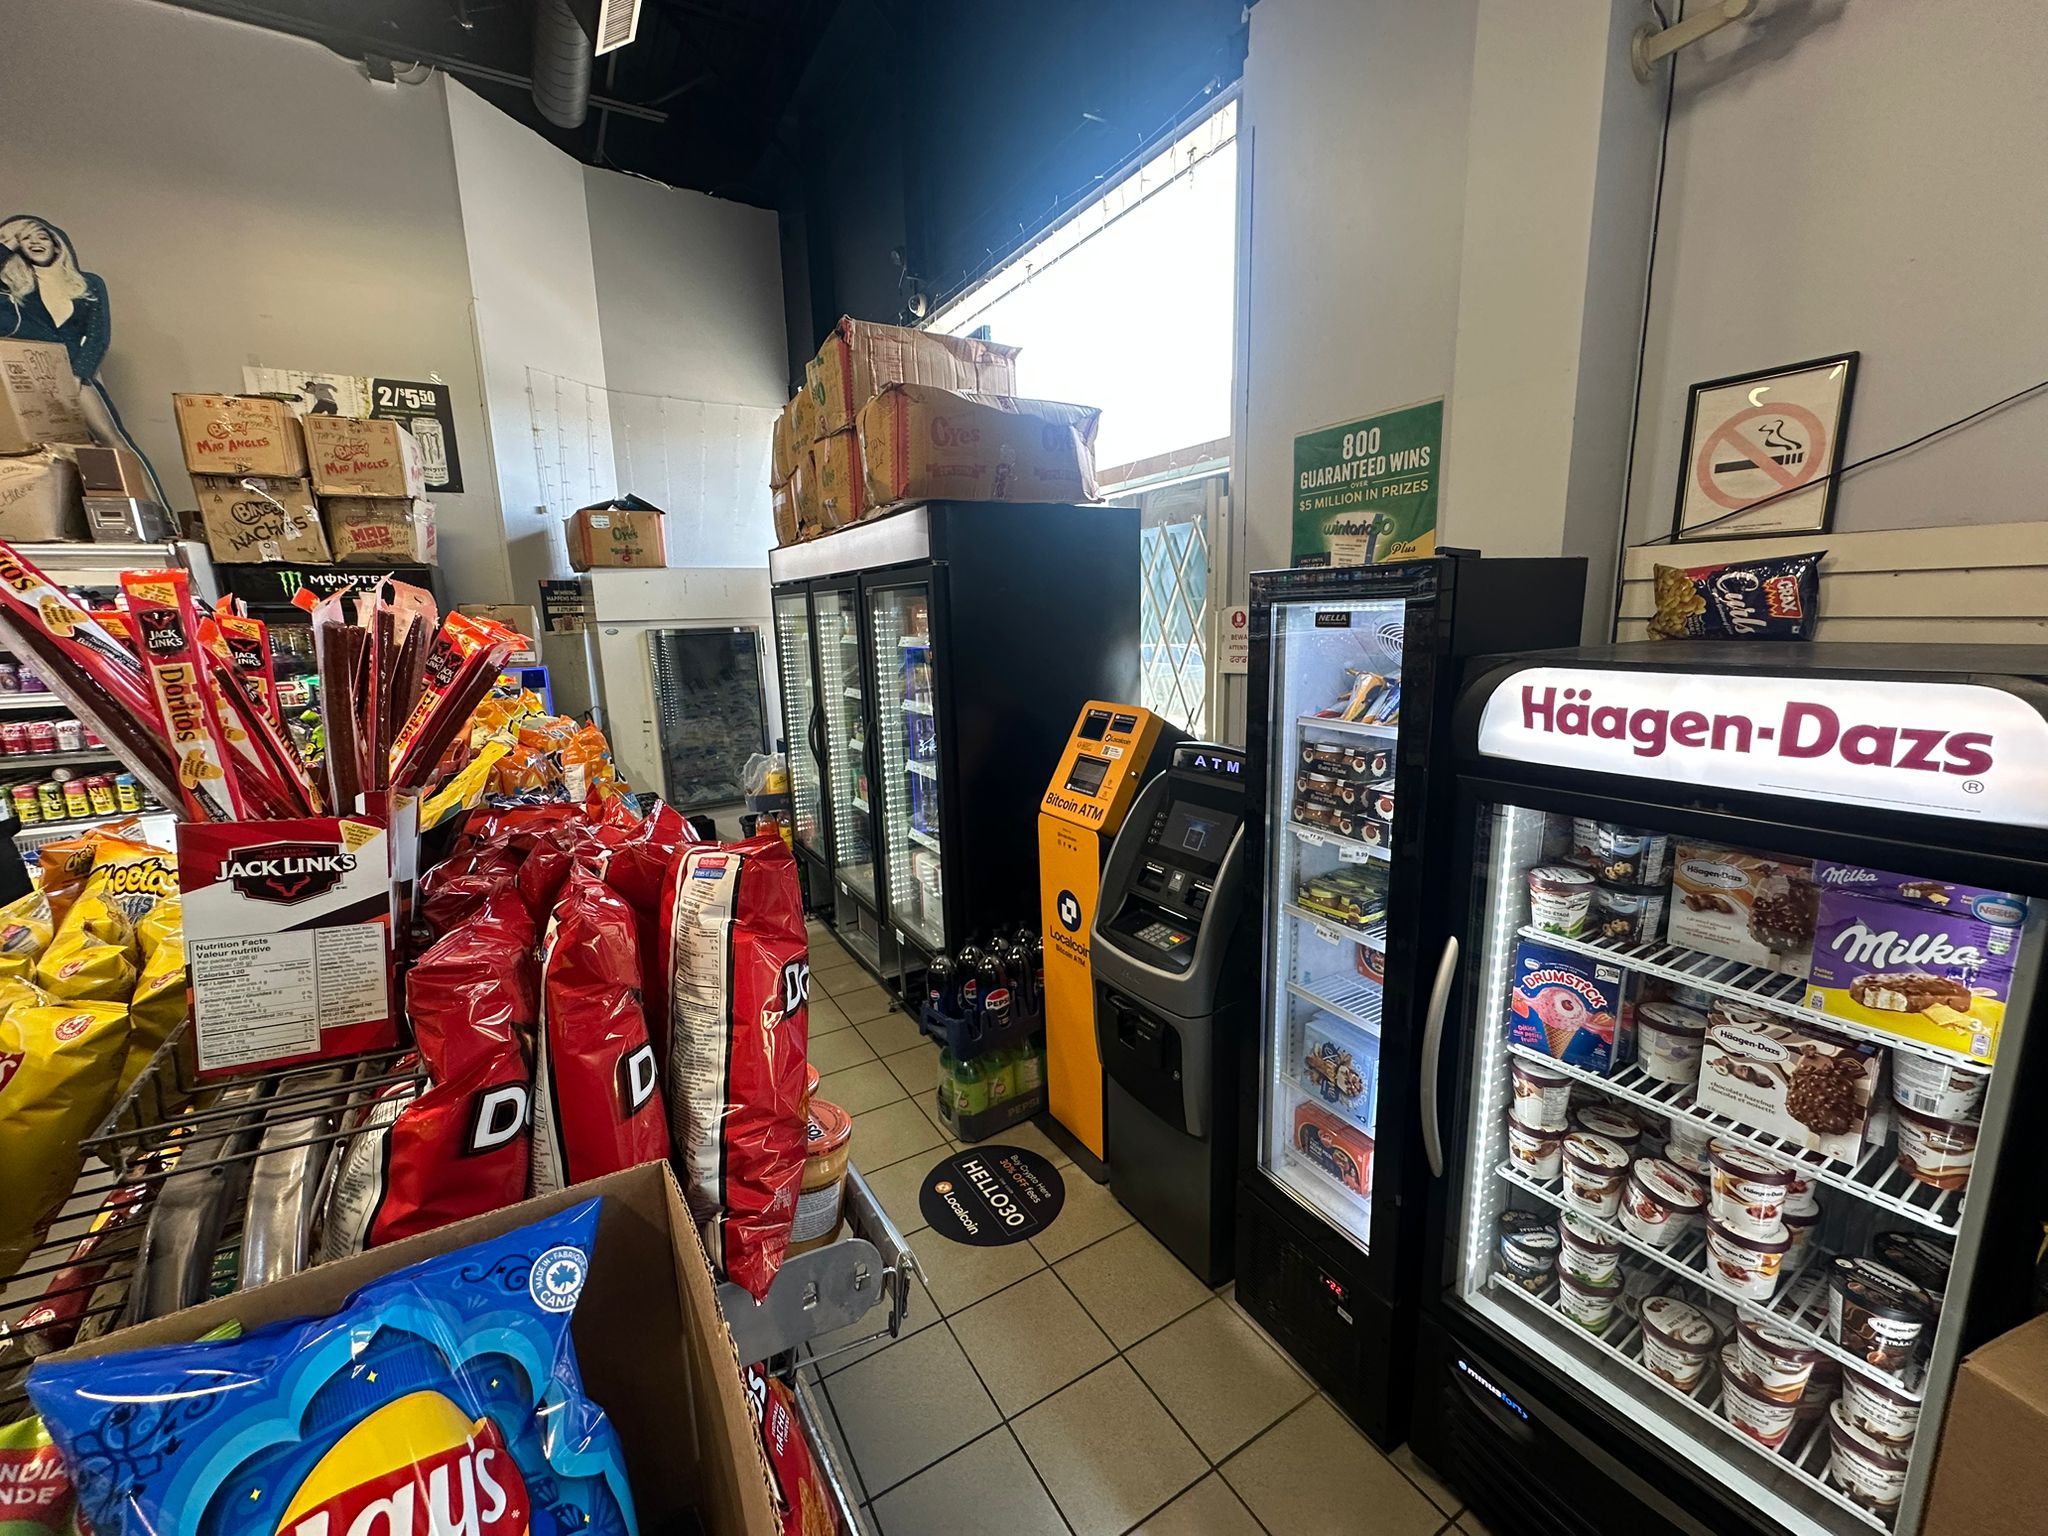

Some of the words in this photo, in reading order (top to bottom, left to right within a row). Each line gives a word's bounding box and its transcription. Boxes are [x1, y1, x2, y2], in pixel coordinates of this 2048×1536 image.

[197, 440, 224, 454] MAD
[229, 437, 271, 452] ANGLES
[1343, 427, 1381, 460] 800
[325, 463, 350, 476] MAD
[353, 459, 389, 474] ANGLES
[1300, 455, 1386, 490] GUARANTEED
[1390, 446, 1431, 472] WINS
[1300, 499, 1312, 512] $5
[1315, 490, 1363, 509] MILLION
[1366, 488, 1378, 500] IN
[1382, 479, 1429, 498] PRIZES
[1350, 480, 1369, 489] OVER
[351, 526, 389, 542] MAD
[356, 538, 393, 550] ANGLES
[1391, 540, 1416, 555] Plus
[1776, 580, 1797, 613] CRAX
[1318, 614, 1347, 623] NELLA
[148, 637, 184, 649] LINK'S
[149, 629, 178, 641] JACK
[235, 652, 257, 661] JACK
[159, 667, 196, 743] Doritos
[1521, 685, 1995, 779] Häagen-Dazs
[1194, 755, 1240, 774] ATM
[1045, 792, 1079, 813] Bitcoin
[1078, 800, 1104, 821] ATM
[216, 858, 280, 881] JACK
[283, 853, 357, 874] LINK'S
[1687, 864, 1742, 883] Häagen-Dazs
[1821, 866, 1878, 883] Milka
[196, 941, 239, 952] Nutrition
[242, 938, 268, 948] Facts
[231, 945, 271, 955] nutritive
[1049, 925, 1090, 959] Localcoin
[1056, 944, 1073, 961] Bitcoin
[1073, 955, 1086, 968] ATM
[1831, 925, 1987, 970] Milka
[1719, 1030, 1781, 1057] Häagen-Dazs
[1708, 1086, 1736, 1101] chocolat
[1746, 1099, 1776, 1115] noisette
[1710, 1081, 1742, 1097] chocolate
[1744, 1091, 1776, 1109] hazelnut
[999, 1158, 1017, 1175] 30%
[1012, 1173, 1030, 1191] OFF
[1024, 1187, 1041, 1204] fees
[1010, 1153, 1022, 1166] Buy
[1019, 1163, 1039, 1185] Crypto
[1037, 1182, 1052, 1199] Here
[962, 1160, 1025, 1227] HELLO30
[943, 1191, 979, 1236] Localcoin
[536, 1266, 544, 1289] MADE
[541, 1257, 552, 1267] IN
[775, 1405, 787, 1457] NACHO
